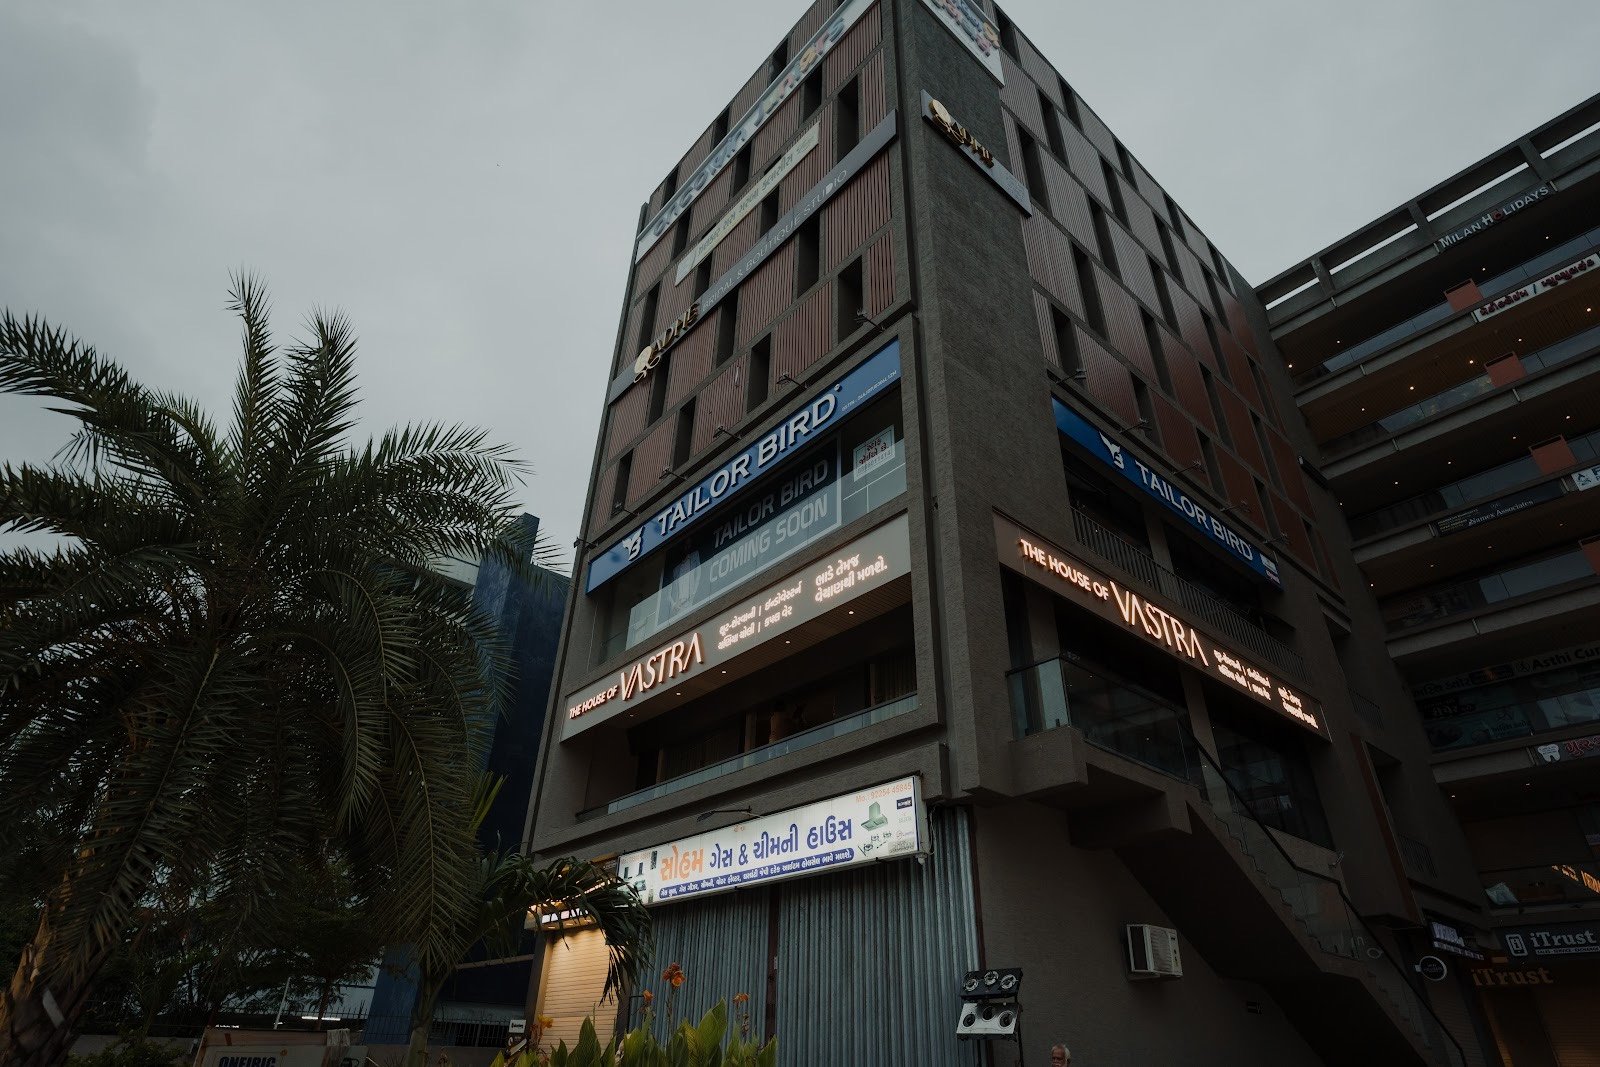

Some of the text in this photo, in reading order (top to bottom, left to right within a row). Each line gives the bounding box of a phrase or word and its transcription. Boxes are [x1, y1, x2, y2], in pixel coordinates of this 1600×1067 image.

[701, 169, 847, 312] BRIDAL & BOUTIQUE STUDIO
[1438, 185, 1549, 248] MILAN HOLIDAYS
[656, 392, 837, 538] TAILOR BIRD
[712, 458, 829, 549] TAILOR BIRD
[709, 492, 829, 583] COMING SOON
[1135, 459, 1254, 561] TAILOR BIRD
[1020, 538, 1210, 667] THE HOUSE OF VASTRA
[569, 632, 704, 719] THE HOUSE OF VASTRA
[1532, 652, 1573, 672] Asthi
[709, 843, 734, 870] ગેસ
[738, 846, 749, 867] &
[753, 823, 799, 860] ચીમની
[806, 815, 853, 851] હાઉસ
[1471, 966, 1554, 987] iTrust
[1530, 930, 1597, 948] iTrust
